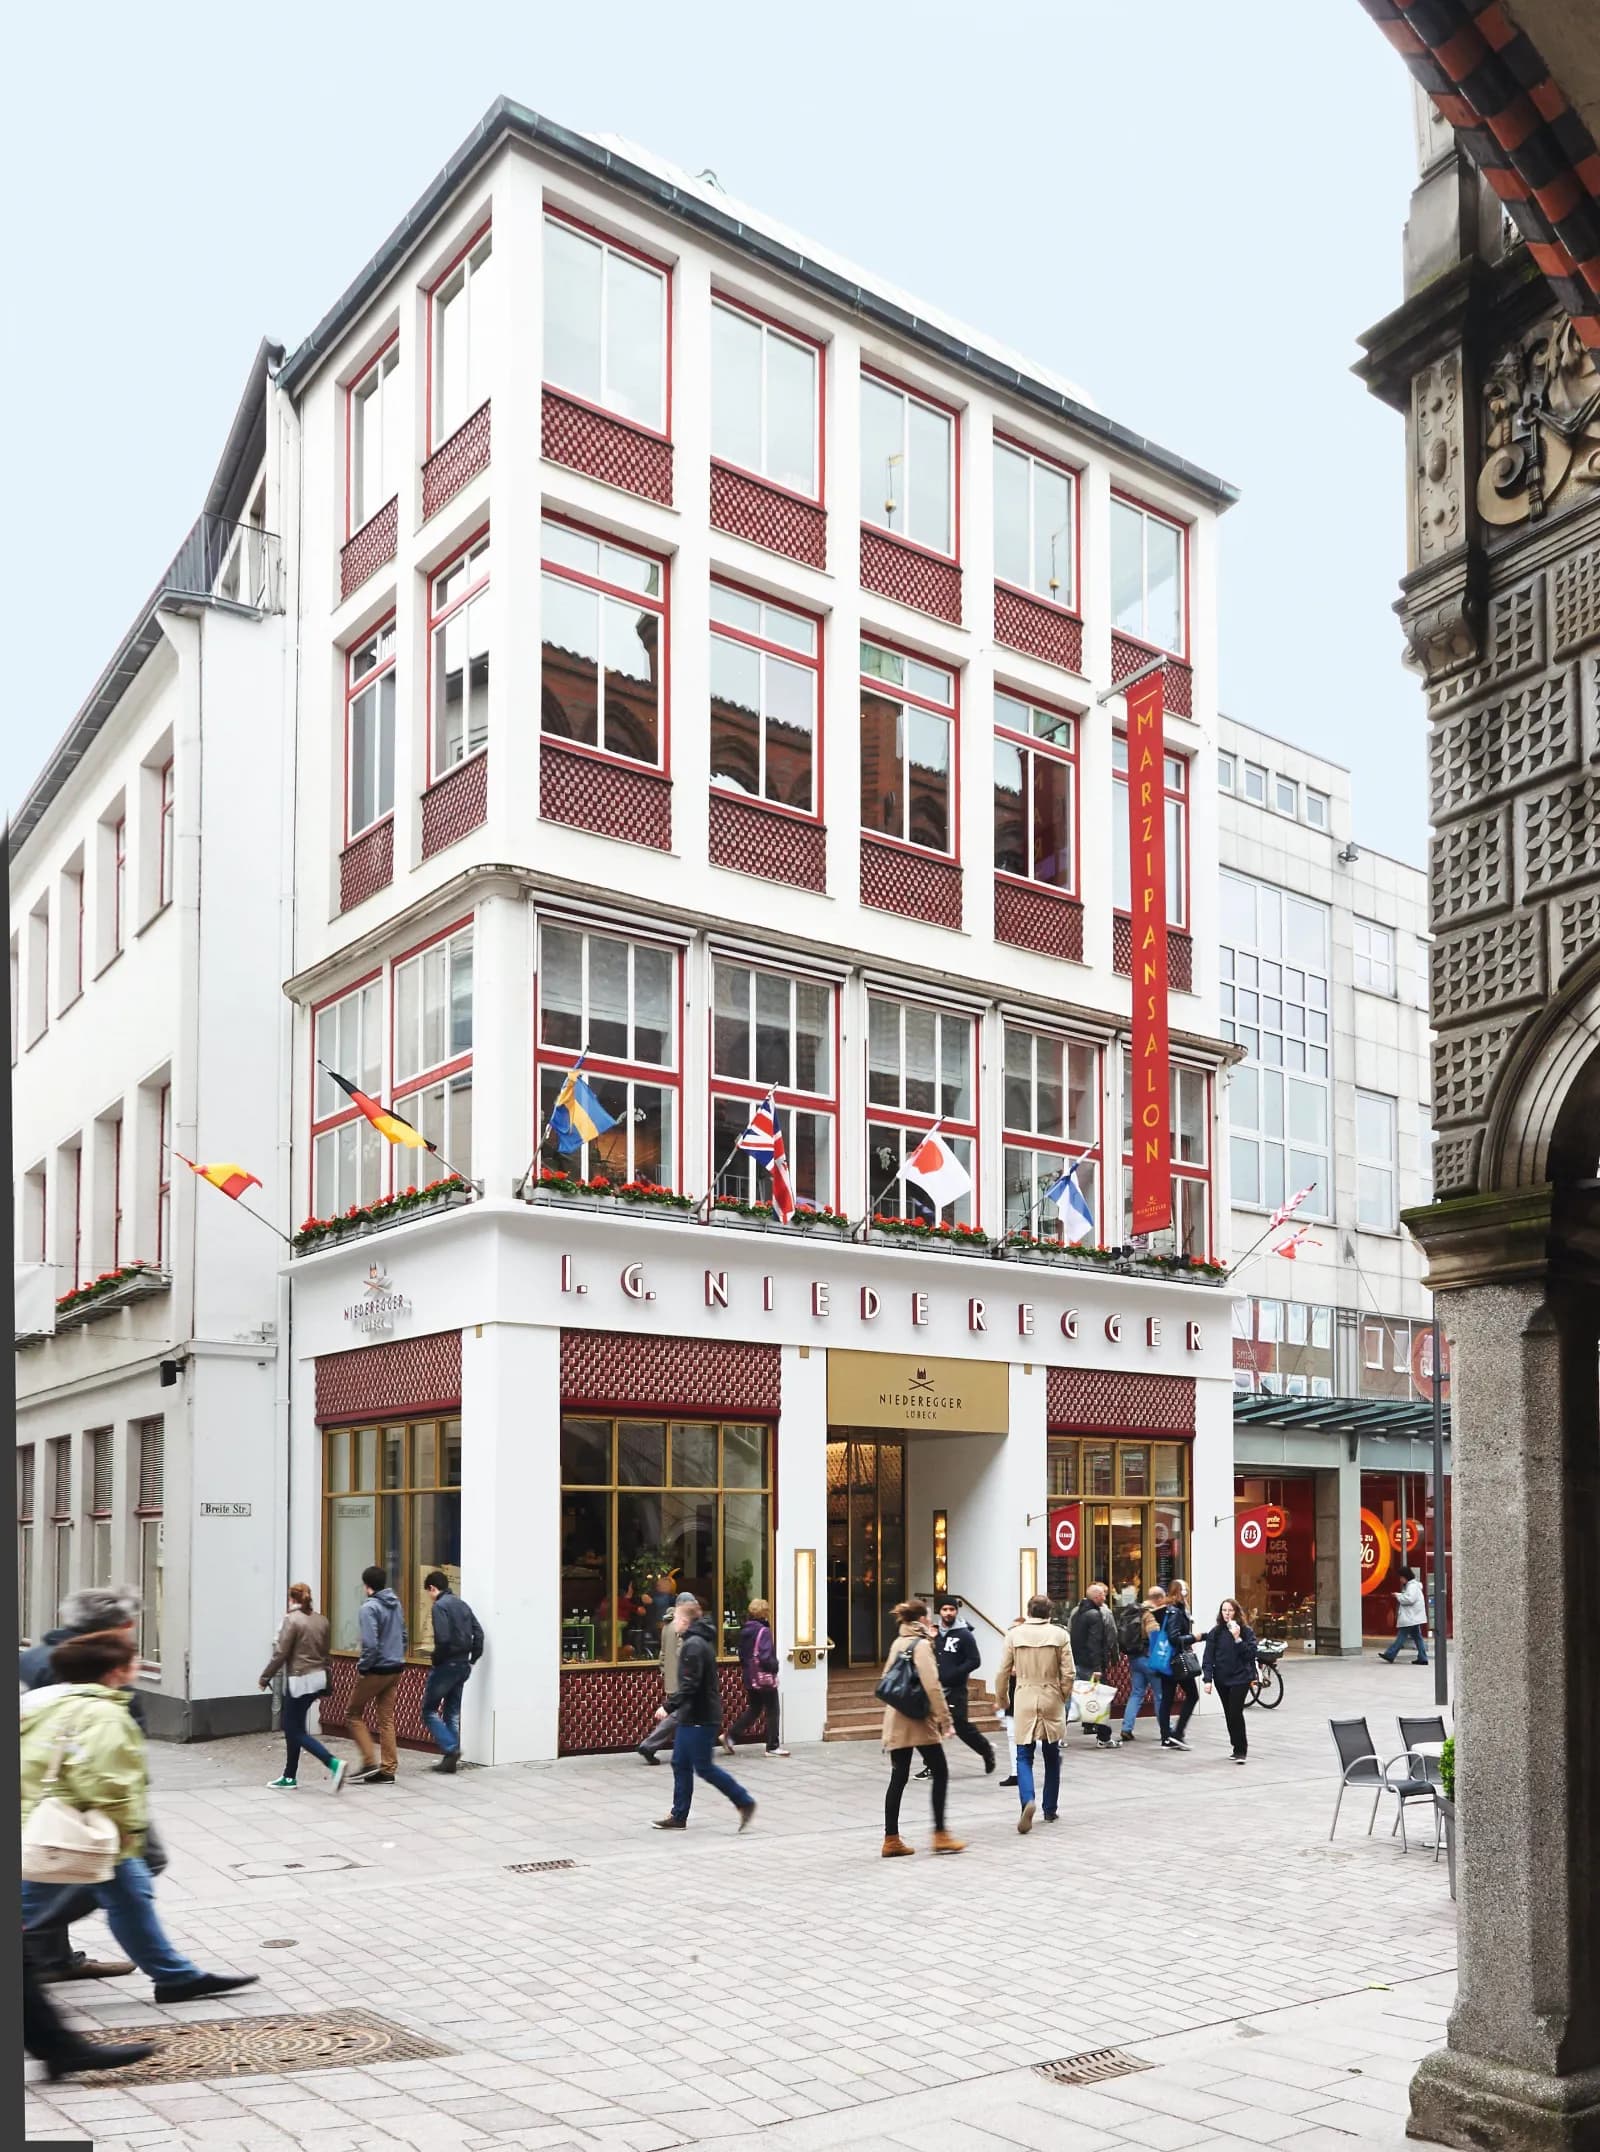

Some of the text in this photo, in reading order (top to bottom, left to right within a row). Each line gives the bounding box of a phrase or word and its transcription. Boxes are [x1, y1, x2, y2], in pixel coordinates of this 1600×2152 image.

[1136, 705, 1160, 1164] MARZIPANSALON
[344, 1294, 404, 1321] NIEDEREGGER
[705, 1270, 1203, 1351] NIEDEREGGER
[880, 1394, 962, 1409] NIEDEREGGER
[205, 1503, 248, 1514] Breite Str.
[1245, 1529, 1257, 1540] EIS
[944, 1636, 960, 1653] K
